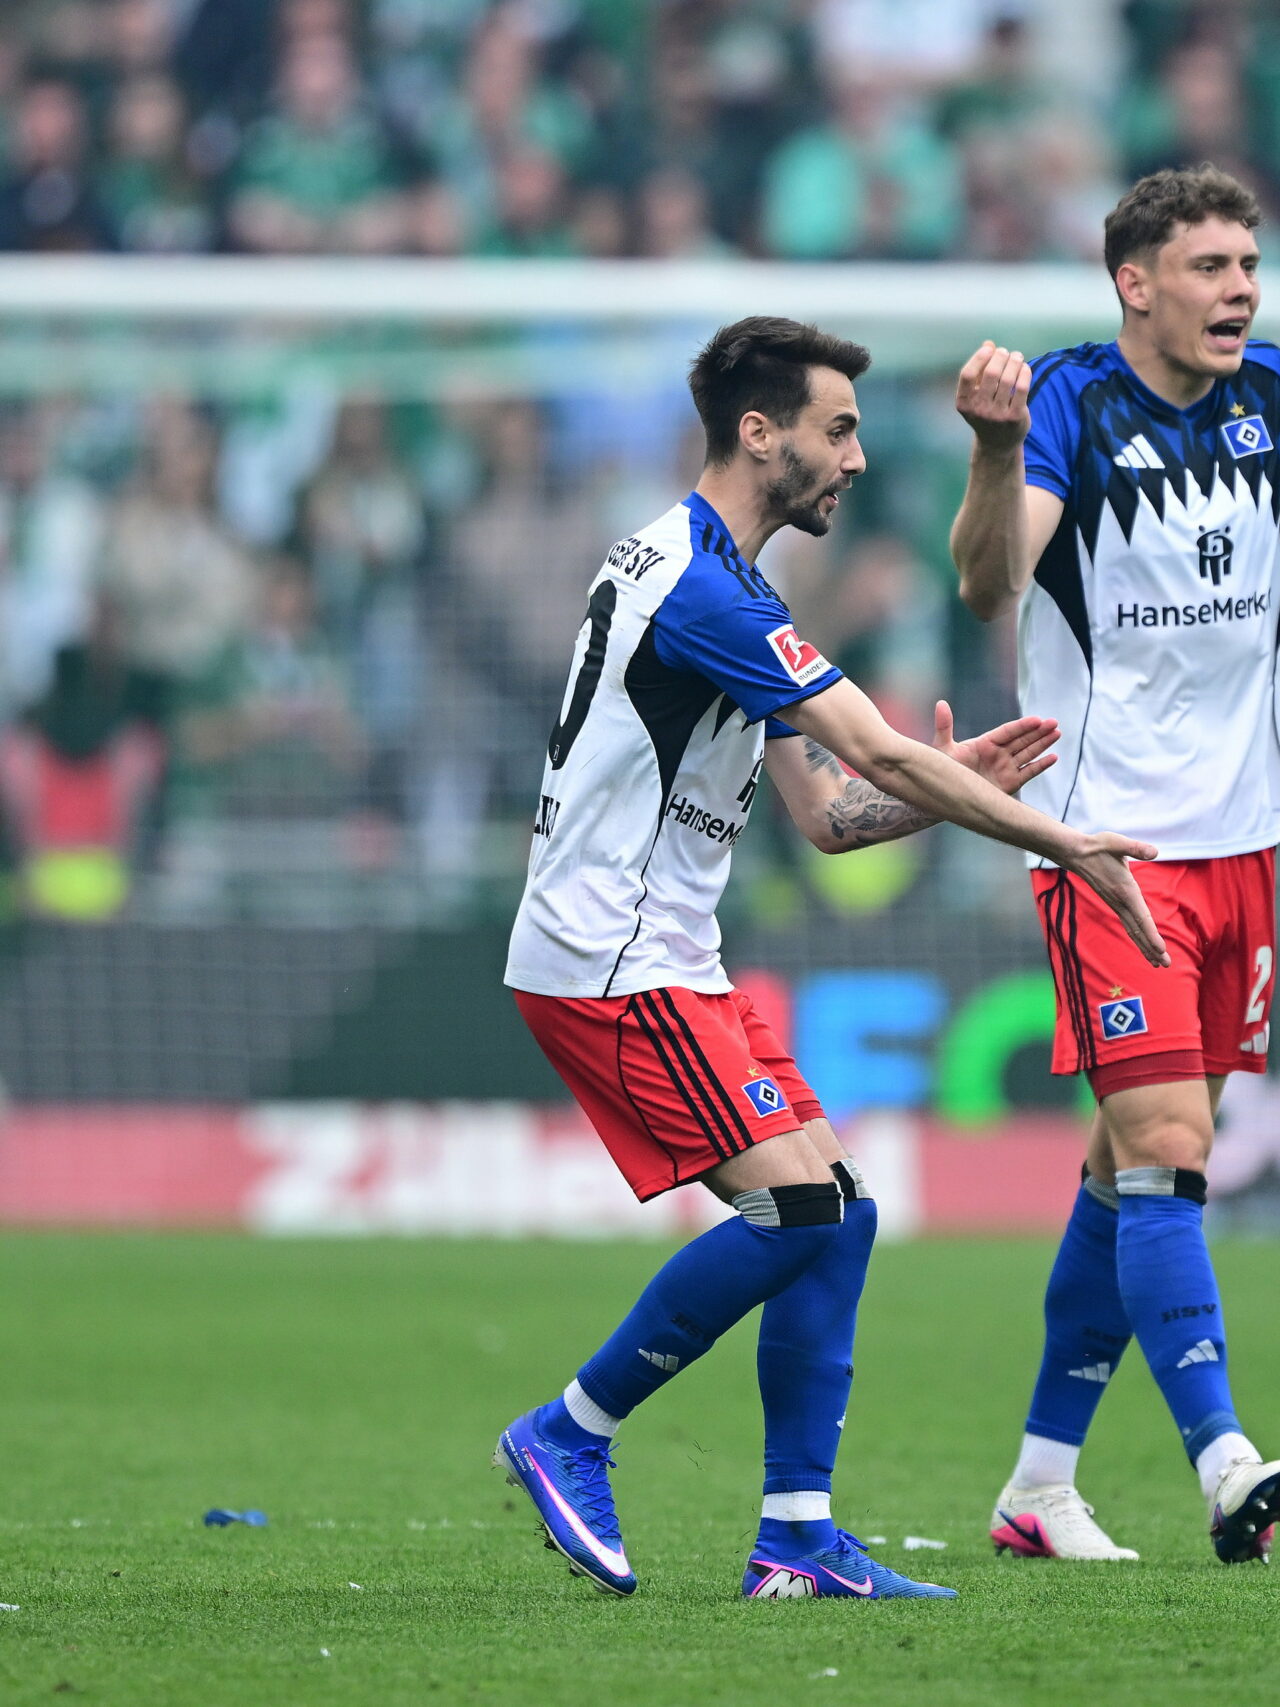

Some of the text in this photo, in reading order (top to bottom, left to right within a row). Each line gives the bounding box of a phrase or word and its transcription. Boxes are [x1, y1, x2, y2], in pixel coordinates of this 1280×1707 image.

[624, 546, 666, 581] SV
[1117, 588, 1271, 628] HanseMerk
[665, 793, 744, 847] HanseM
[1245, 945, 1273, 1024] 2
[1161, 1303, 1217, 1325] HSV
